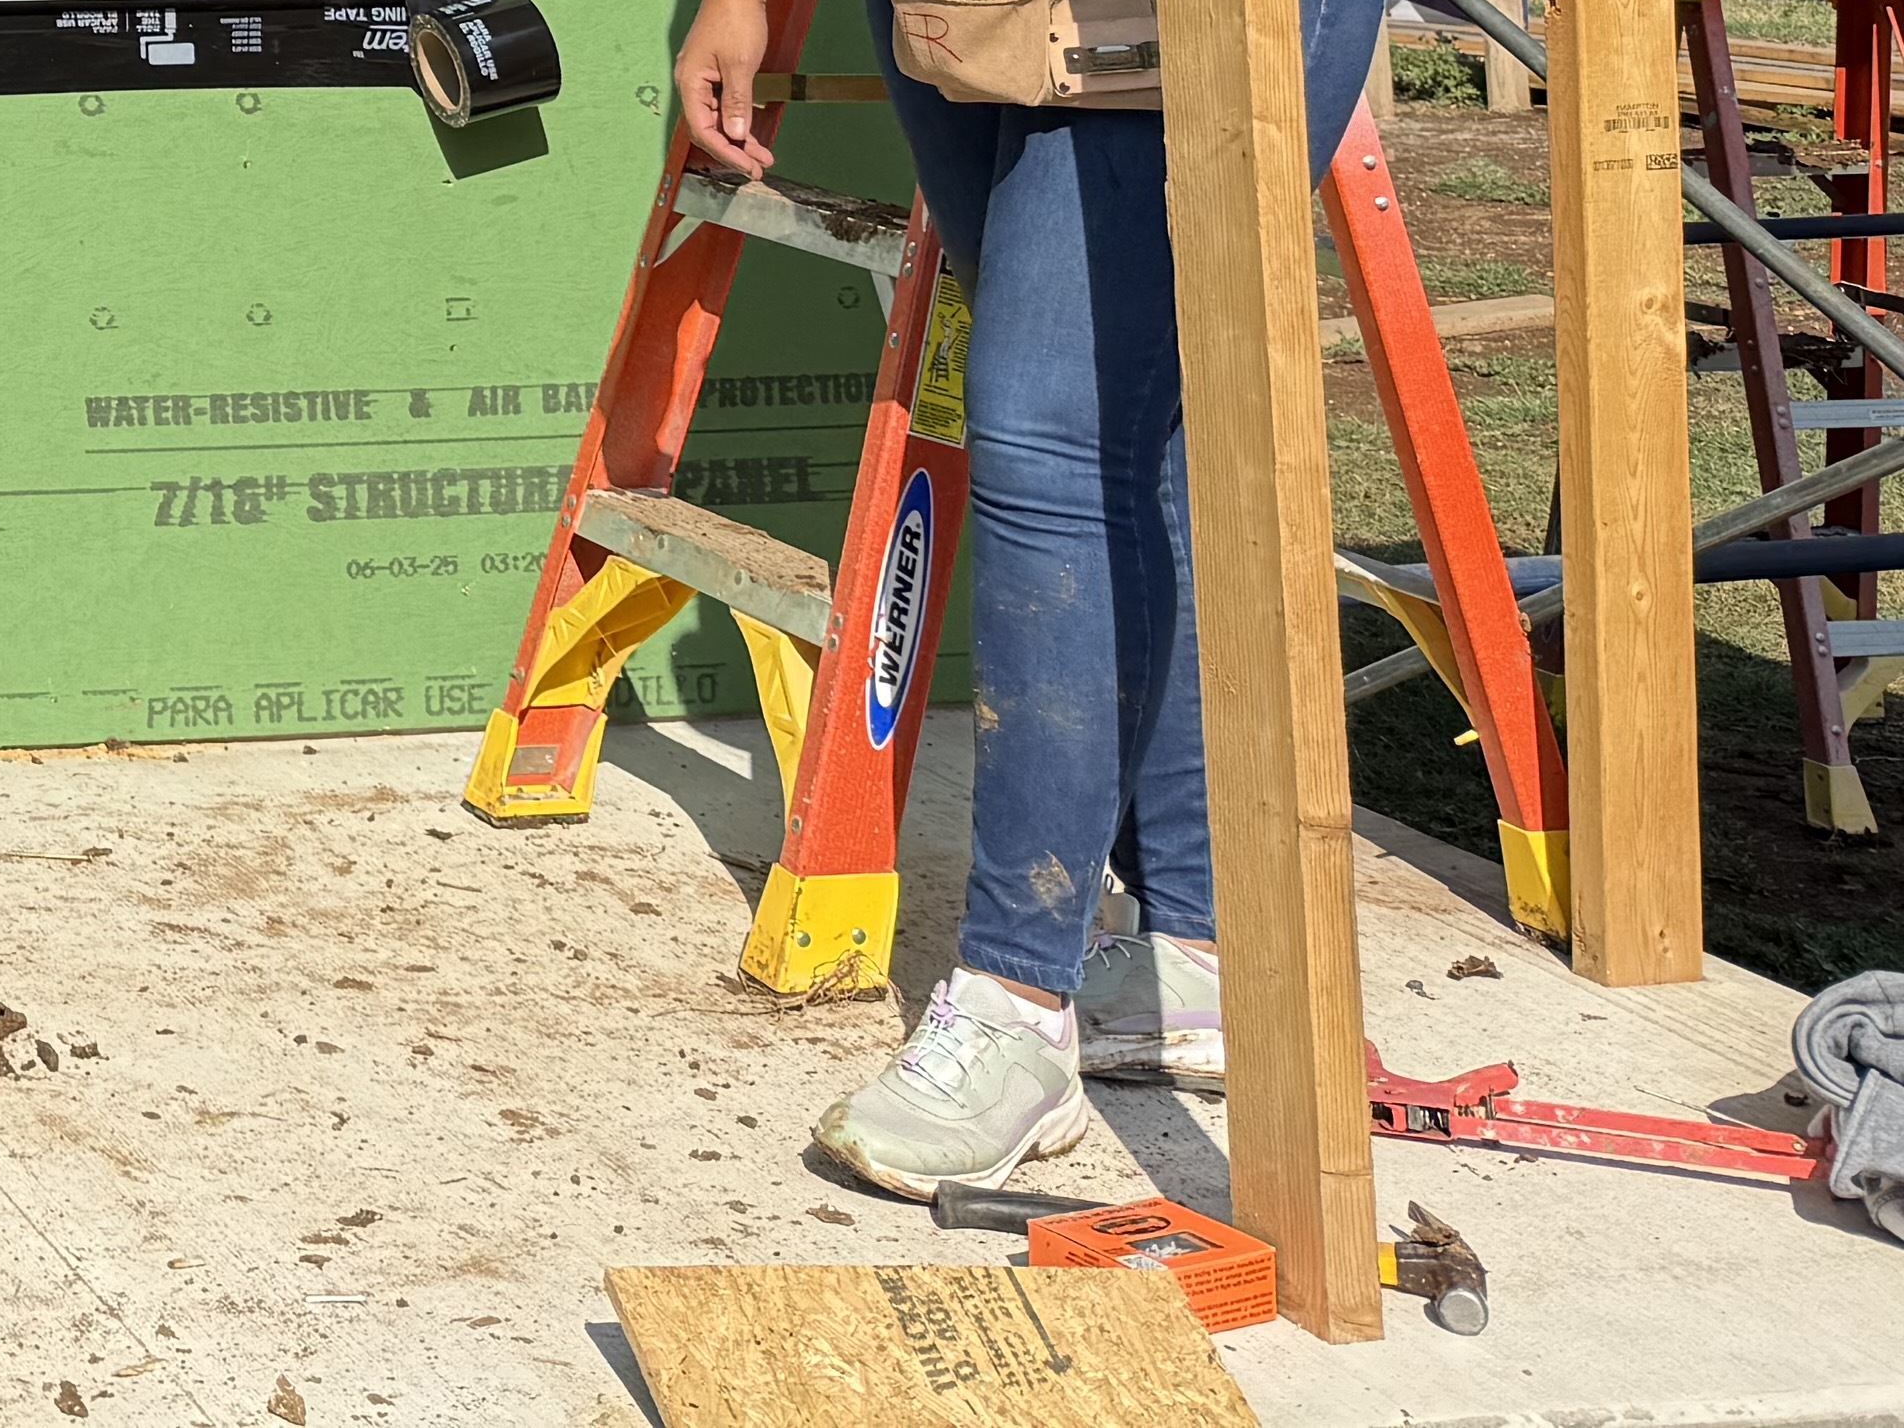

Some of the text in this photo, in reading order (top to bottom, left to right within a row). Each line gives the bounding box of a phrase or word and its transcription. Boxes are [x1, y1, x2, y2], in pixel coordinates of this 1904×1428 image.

[324, 6, 369, 22] TAPE
[85, 389, 373, 429] WATER-RESISTIVE
[407, 388, 432, 419] &
[467, 383, 523, 417] AIR
[149, 476, 289, 531] 7/16"
[345, 552, 461, 581] 06-03-25
[879, 525, 921, 687] WERNER
[145, 693, 234, 730] PARA
[252, 687, 406, 726] APLICAR
[423, 683, 487, 719] USE
